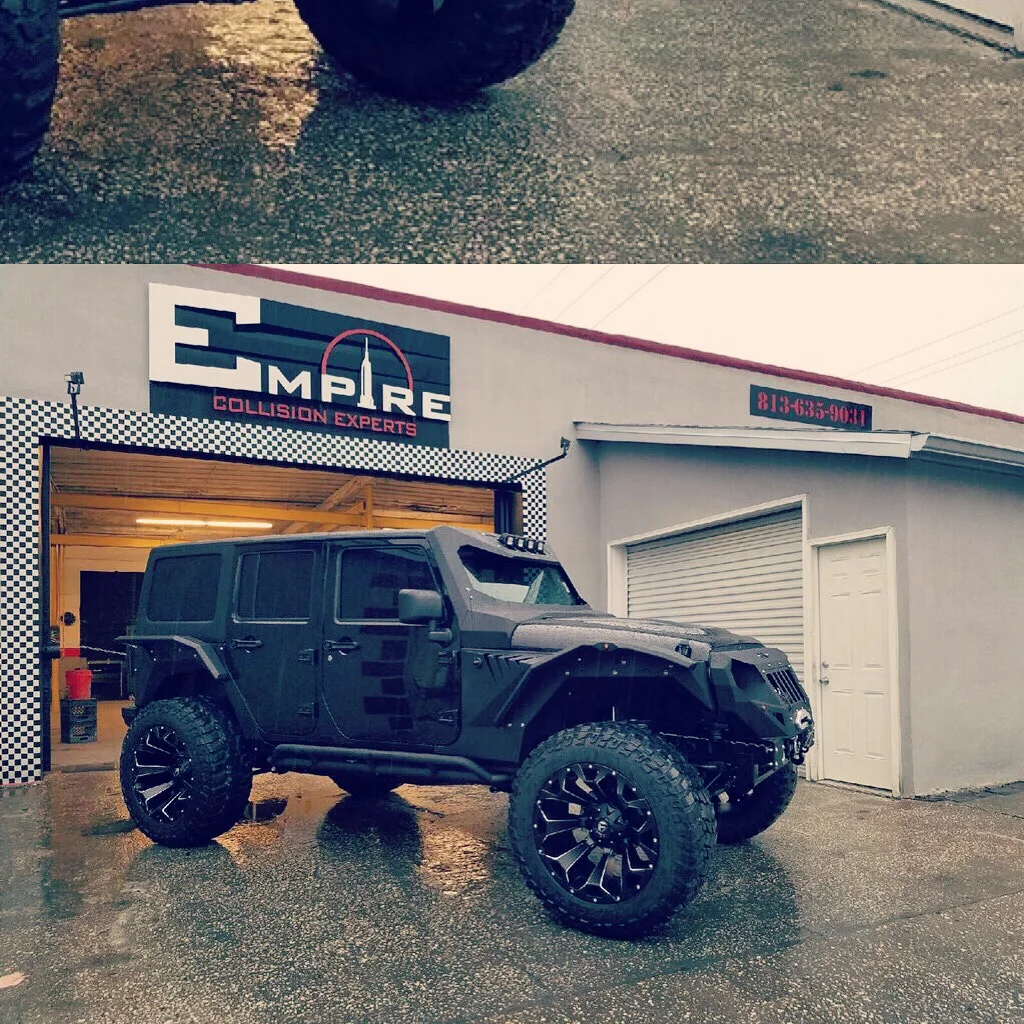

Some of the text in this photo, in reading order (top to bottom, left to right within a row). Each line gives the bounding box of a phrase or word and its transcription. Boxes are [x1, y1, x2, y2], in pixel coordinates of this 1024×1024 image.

[149, 282, 452, 422] EMPIRE
[213, 395, 418, 437] COLLISION EXPERTS
[757, 391, 866, 427] 813-635-9031
